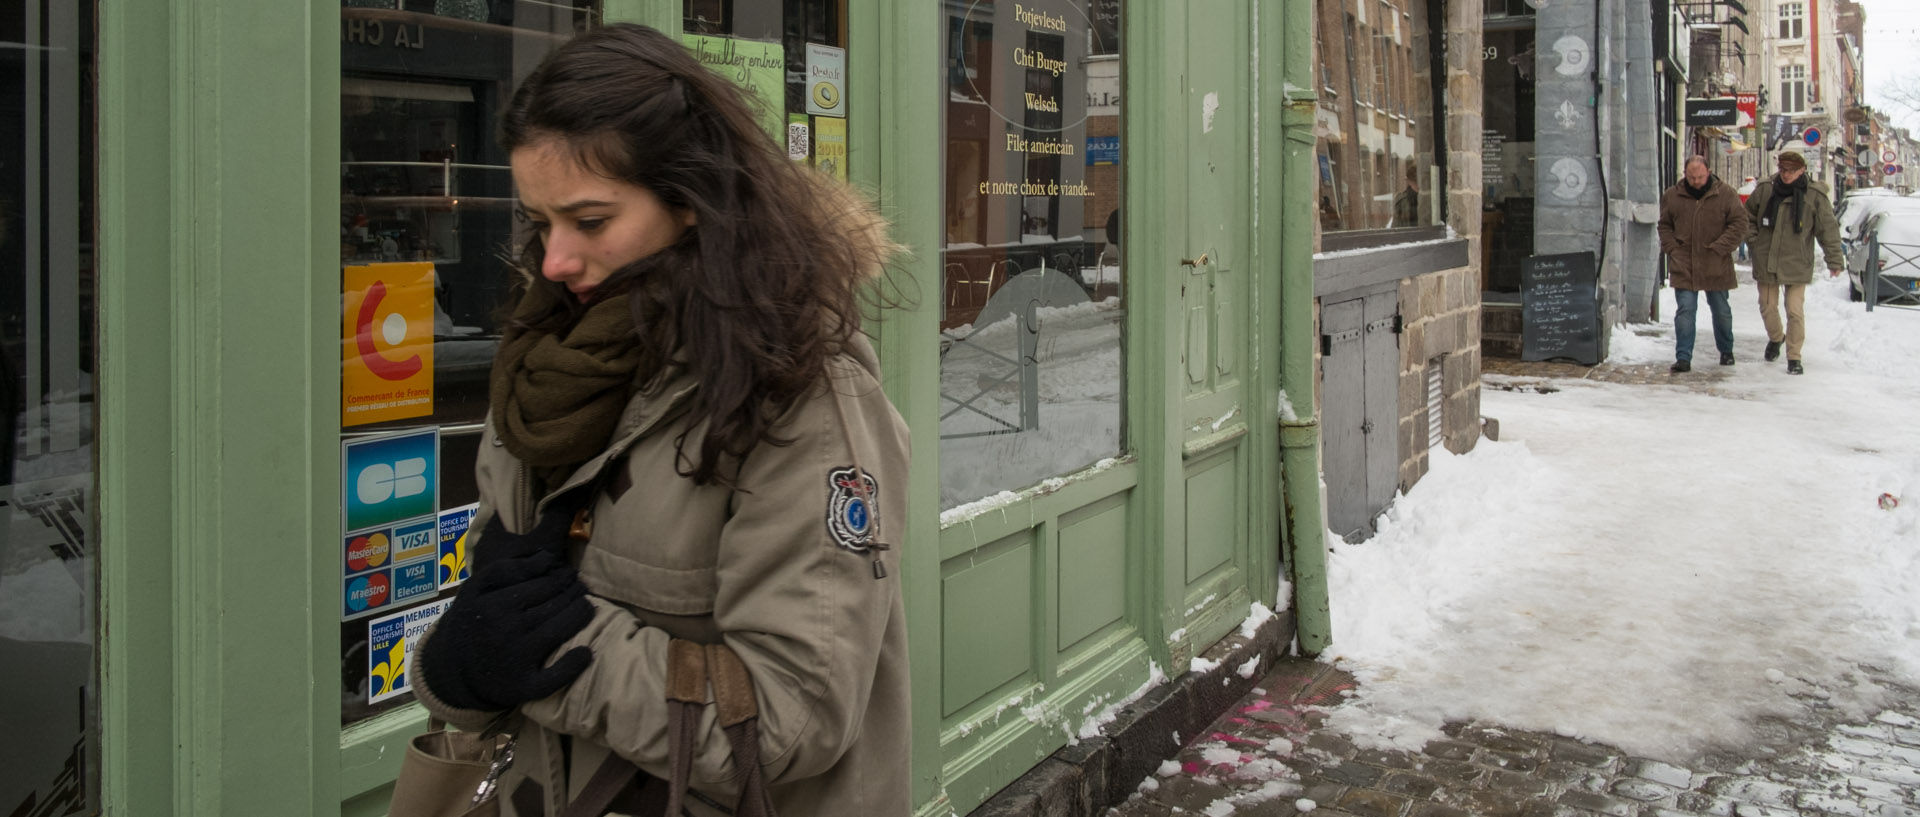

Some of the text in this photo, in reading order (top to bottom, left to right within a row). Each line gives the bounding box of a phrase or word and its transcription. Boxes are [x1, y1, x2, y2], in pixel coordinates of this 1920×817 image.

[1015, 4, 1066, 32] Potjevlesch
[697, 38, 782, 82] Veuillez entrer
[1014, 47, 1067, 77] Chti Burger
[1025, 92, 1057, 112] Welsch
[1737, 96, 1755, 104] TOP
[818, 144, 844, 156] 2010
[1006, 133, 1074, 155] Filet américain
[980, 178, 1095, 196] et notre choix de viande...
[395, 390, 405, 398] de
[407, 388, 430, 397] France
[357, 457, 427, 504] CB
[440, 518, 459, 529] OFFICE
[441, 522, 468, 535] TOURISME
[401, 532, 430, 550] VISA
[441, 534, 456, 542] LILLE
[348, 543, 389, 561] MasterCard
[405, 564, 426, 578] VISA
[351, 584, 385, 600] Maestro
[397, 582, 433, 598] Electron
[405, 605, 440, 623] MEMBRE
[372, 621, 404, 636] OFFICE DE
[373, 629, 404, 643] TOURISME
[373, 641, 389, 651] LILLE
[405, 641, 415, 653] LIL
